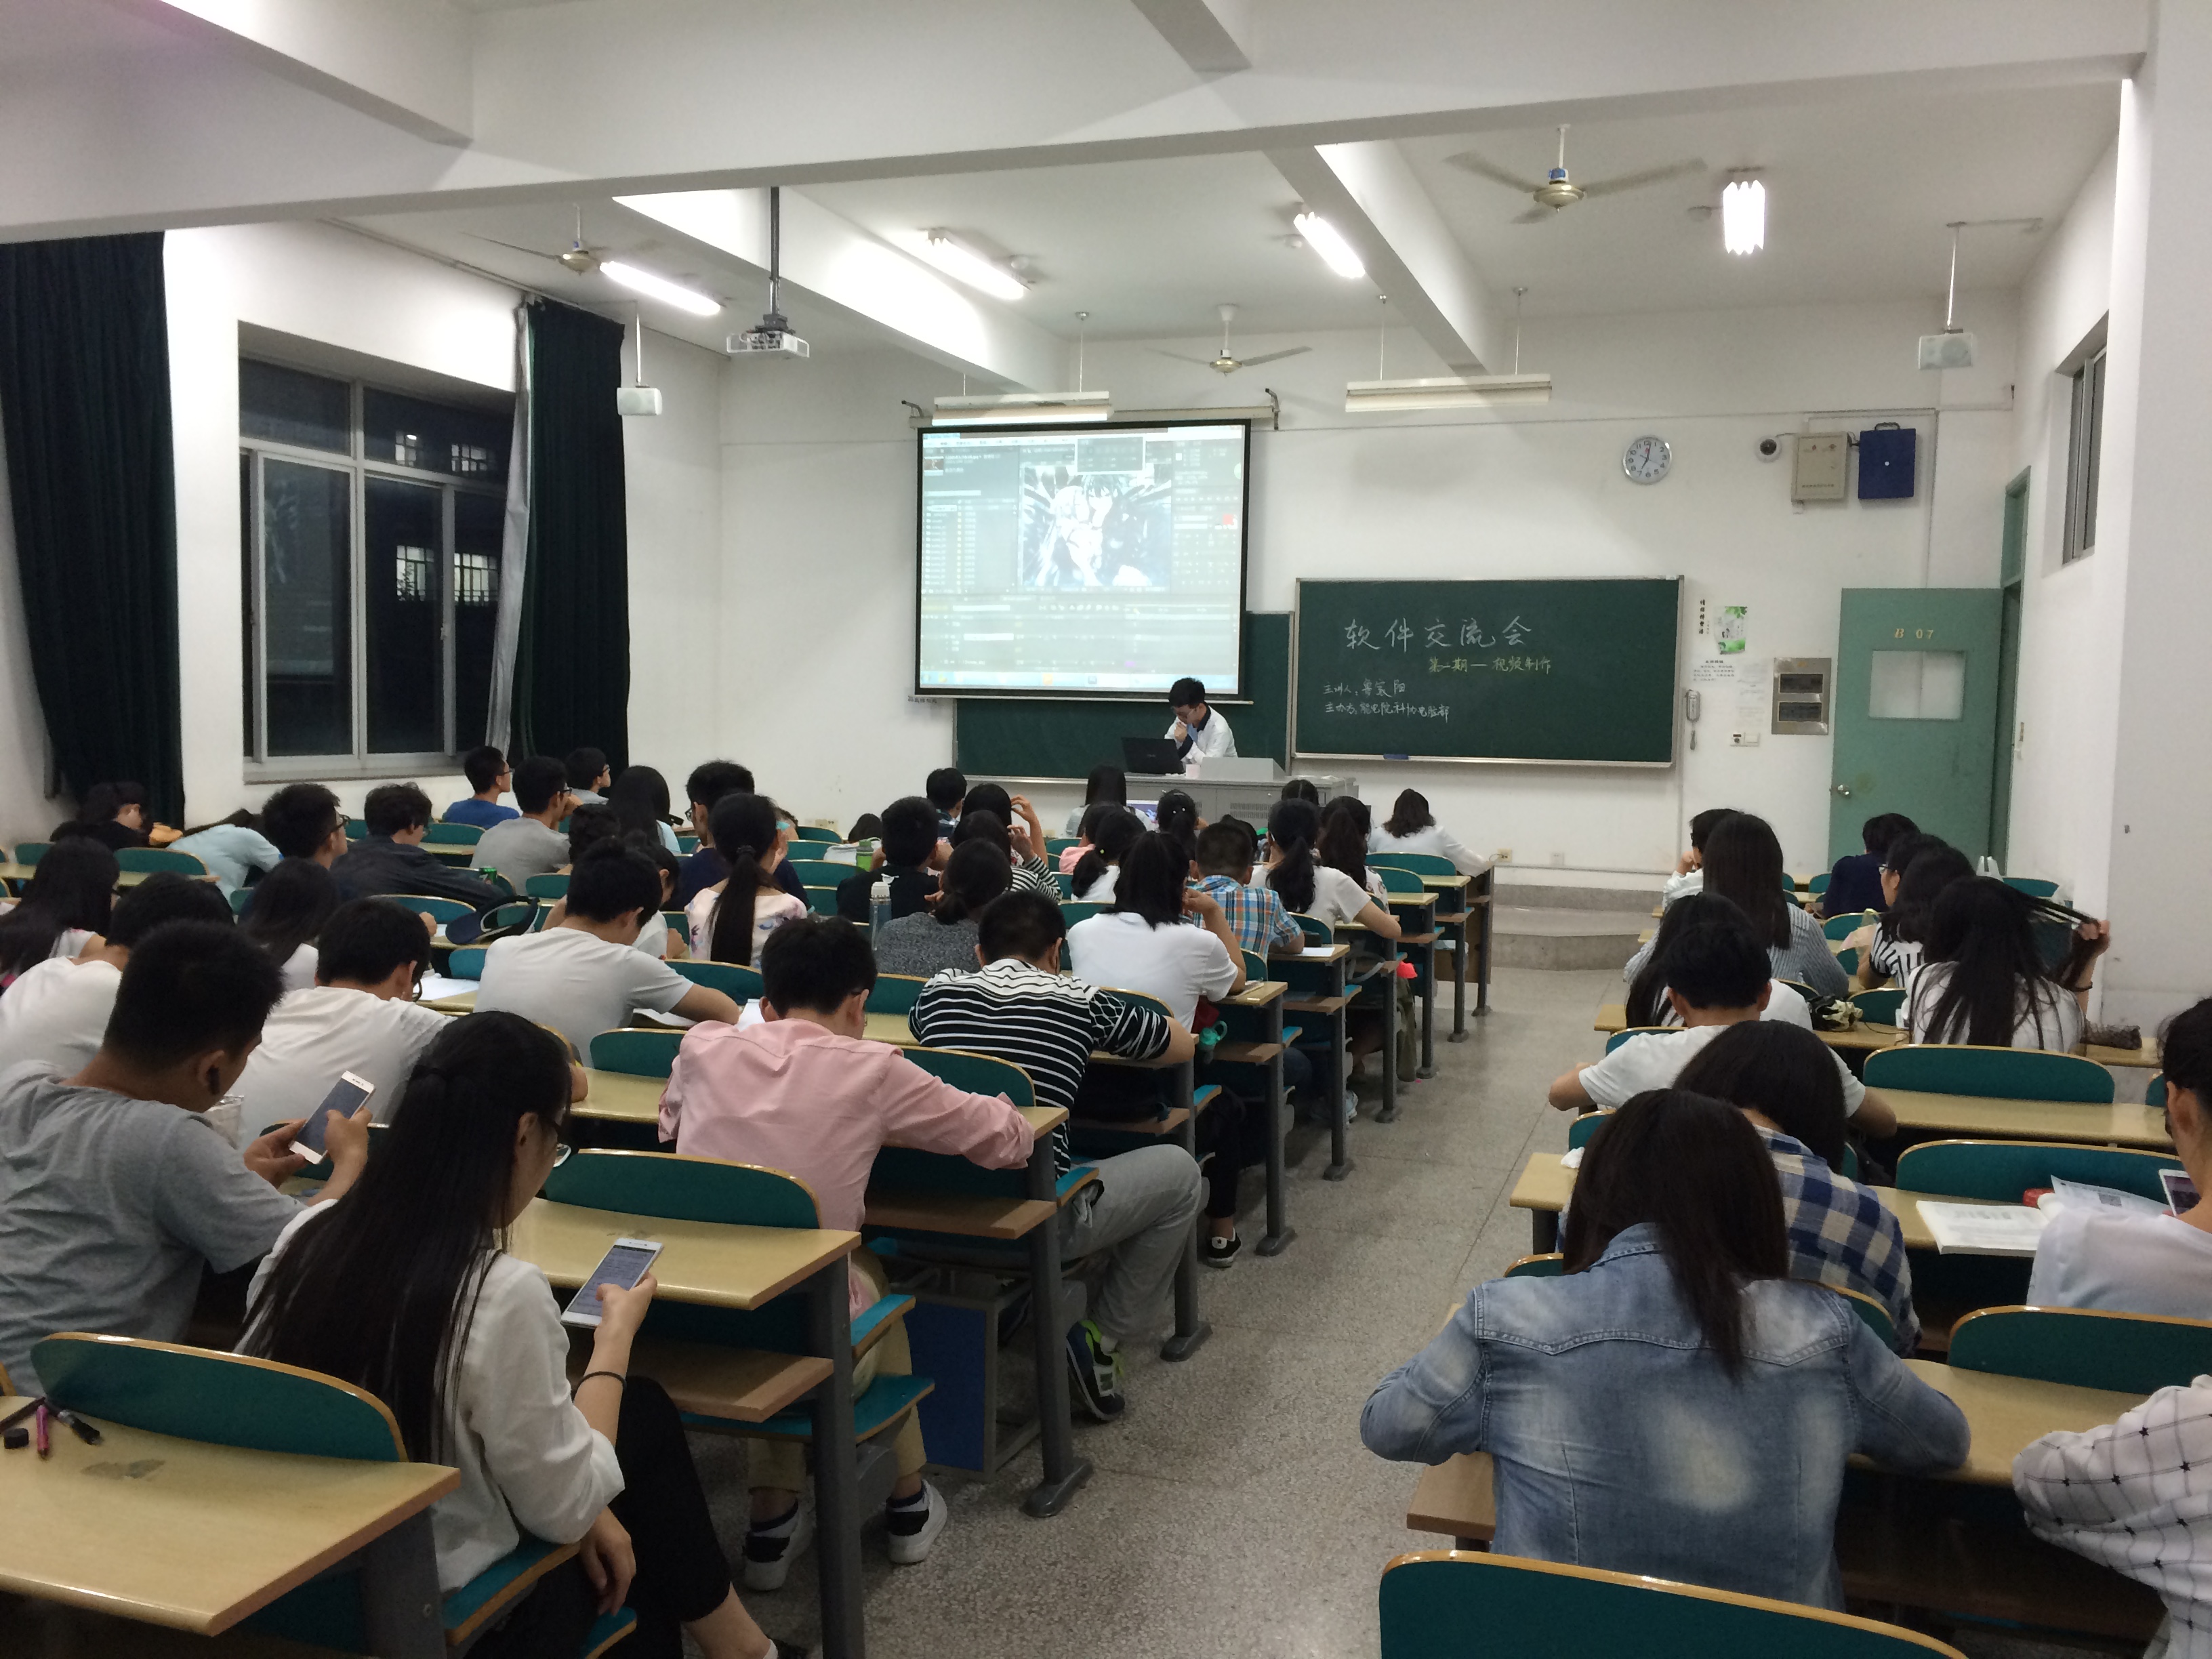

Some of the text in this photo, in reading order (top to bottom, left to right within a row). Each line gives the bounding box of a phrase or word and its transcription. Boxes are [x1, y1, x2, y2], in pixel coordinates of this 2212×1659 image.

[1345, 615, 1532, 653] 软件交流会
